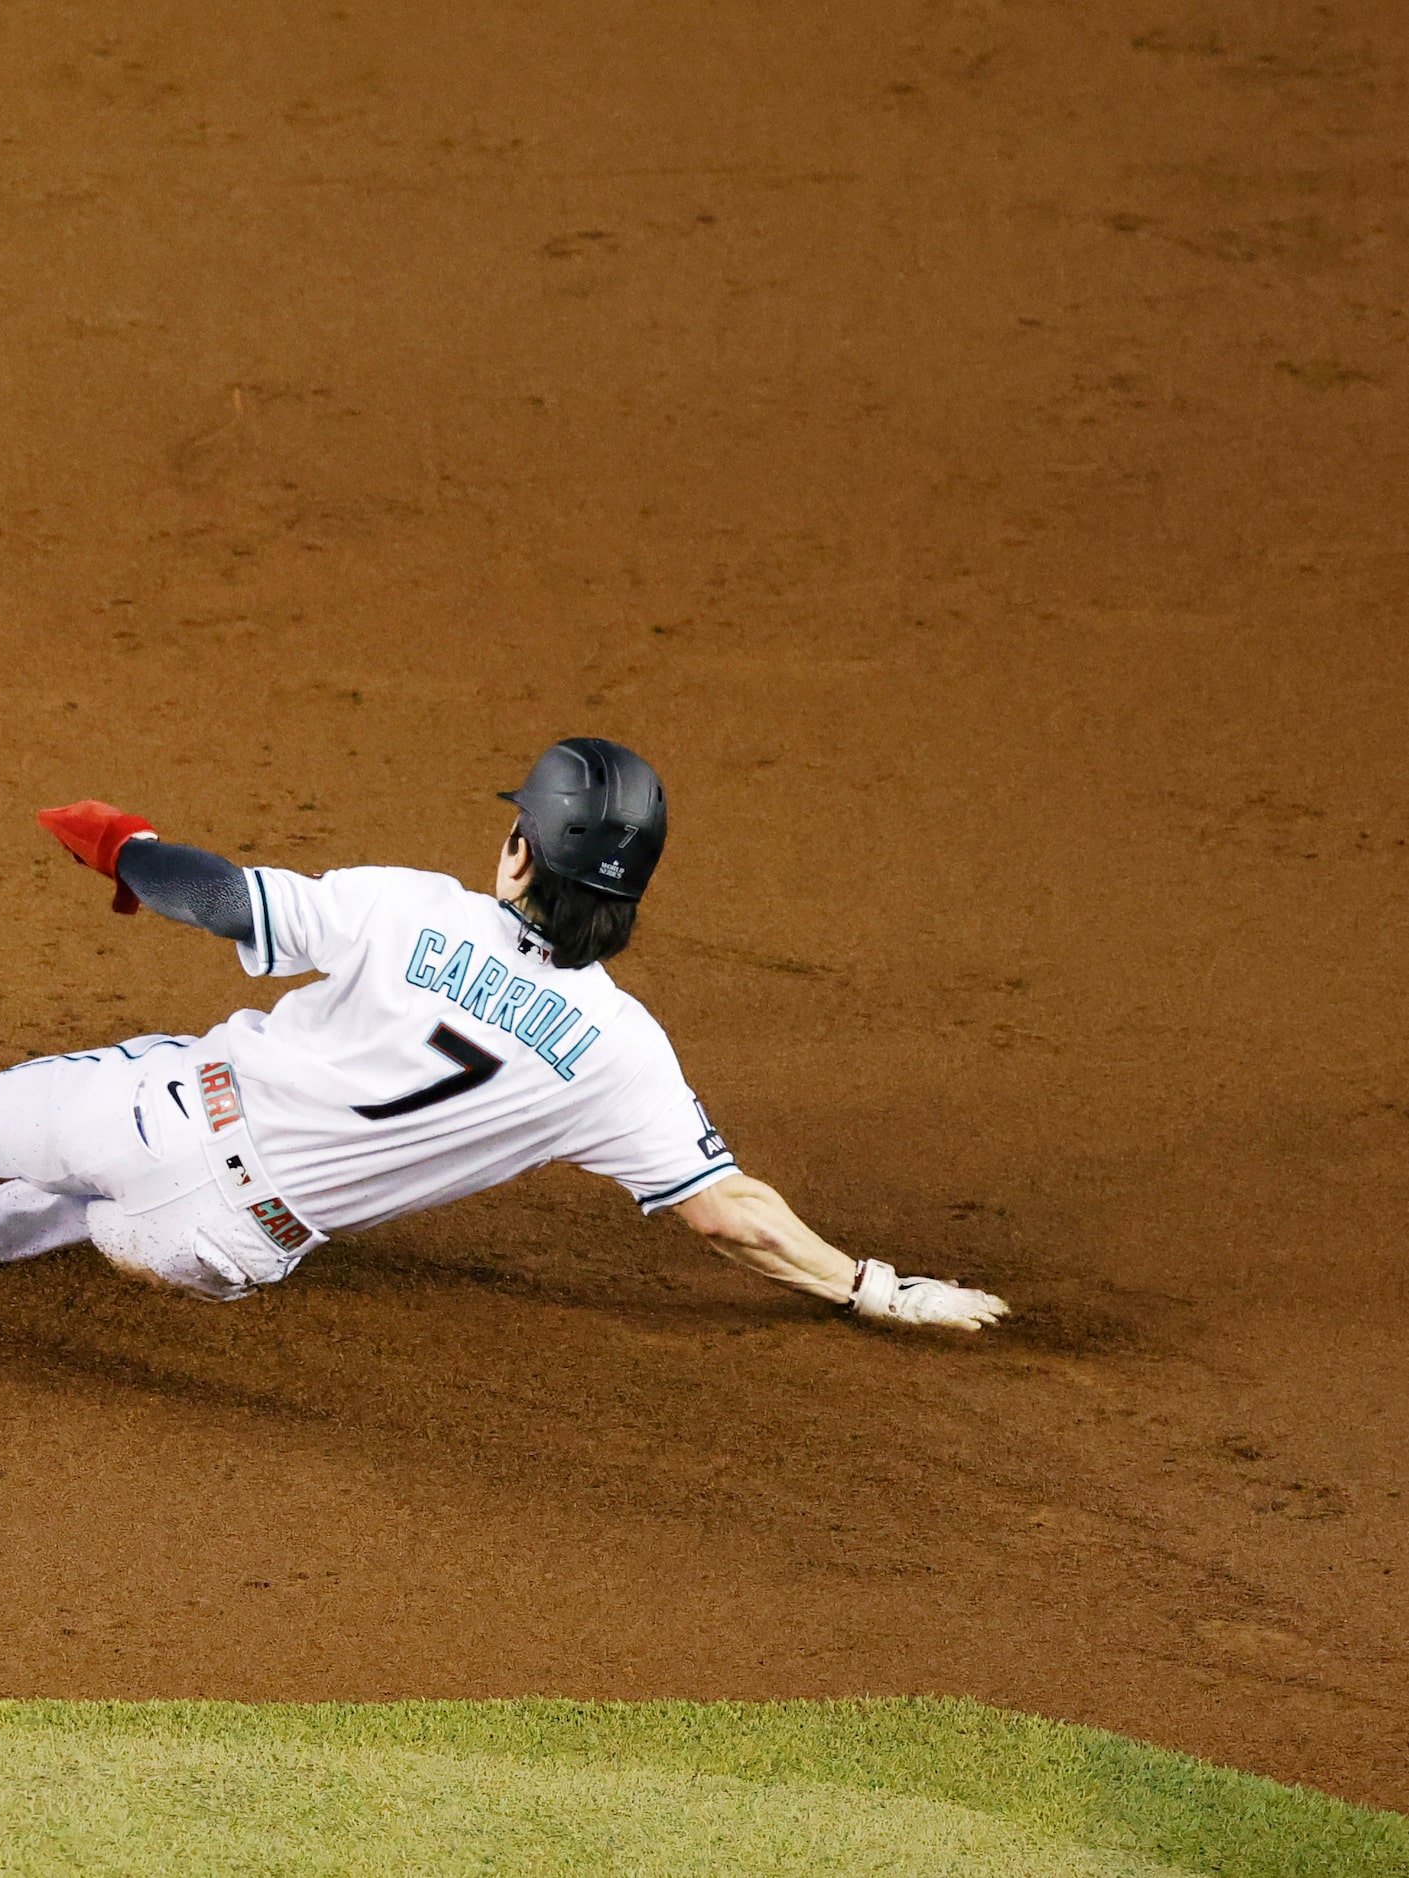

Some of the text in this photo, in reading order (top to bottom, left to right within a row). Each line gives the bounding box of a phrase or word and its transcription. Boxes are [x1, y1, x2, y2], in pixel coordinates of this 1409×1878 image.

[618, 824, 639, 849] 7
[405, 928, 601, 1082] CARROLL
[348, 1018, 507, 1122] 7
